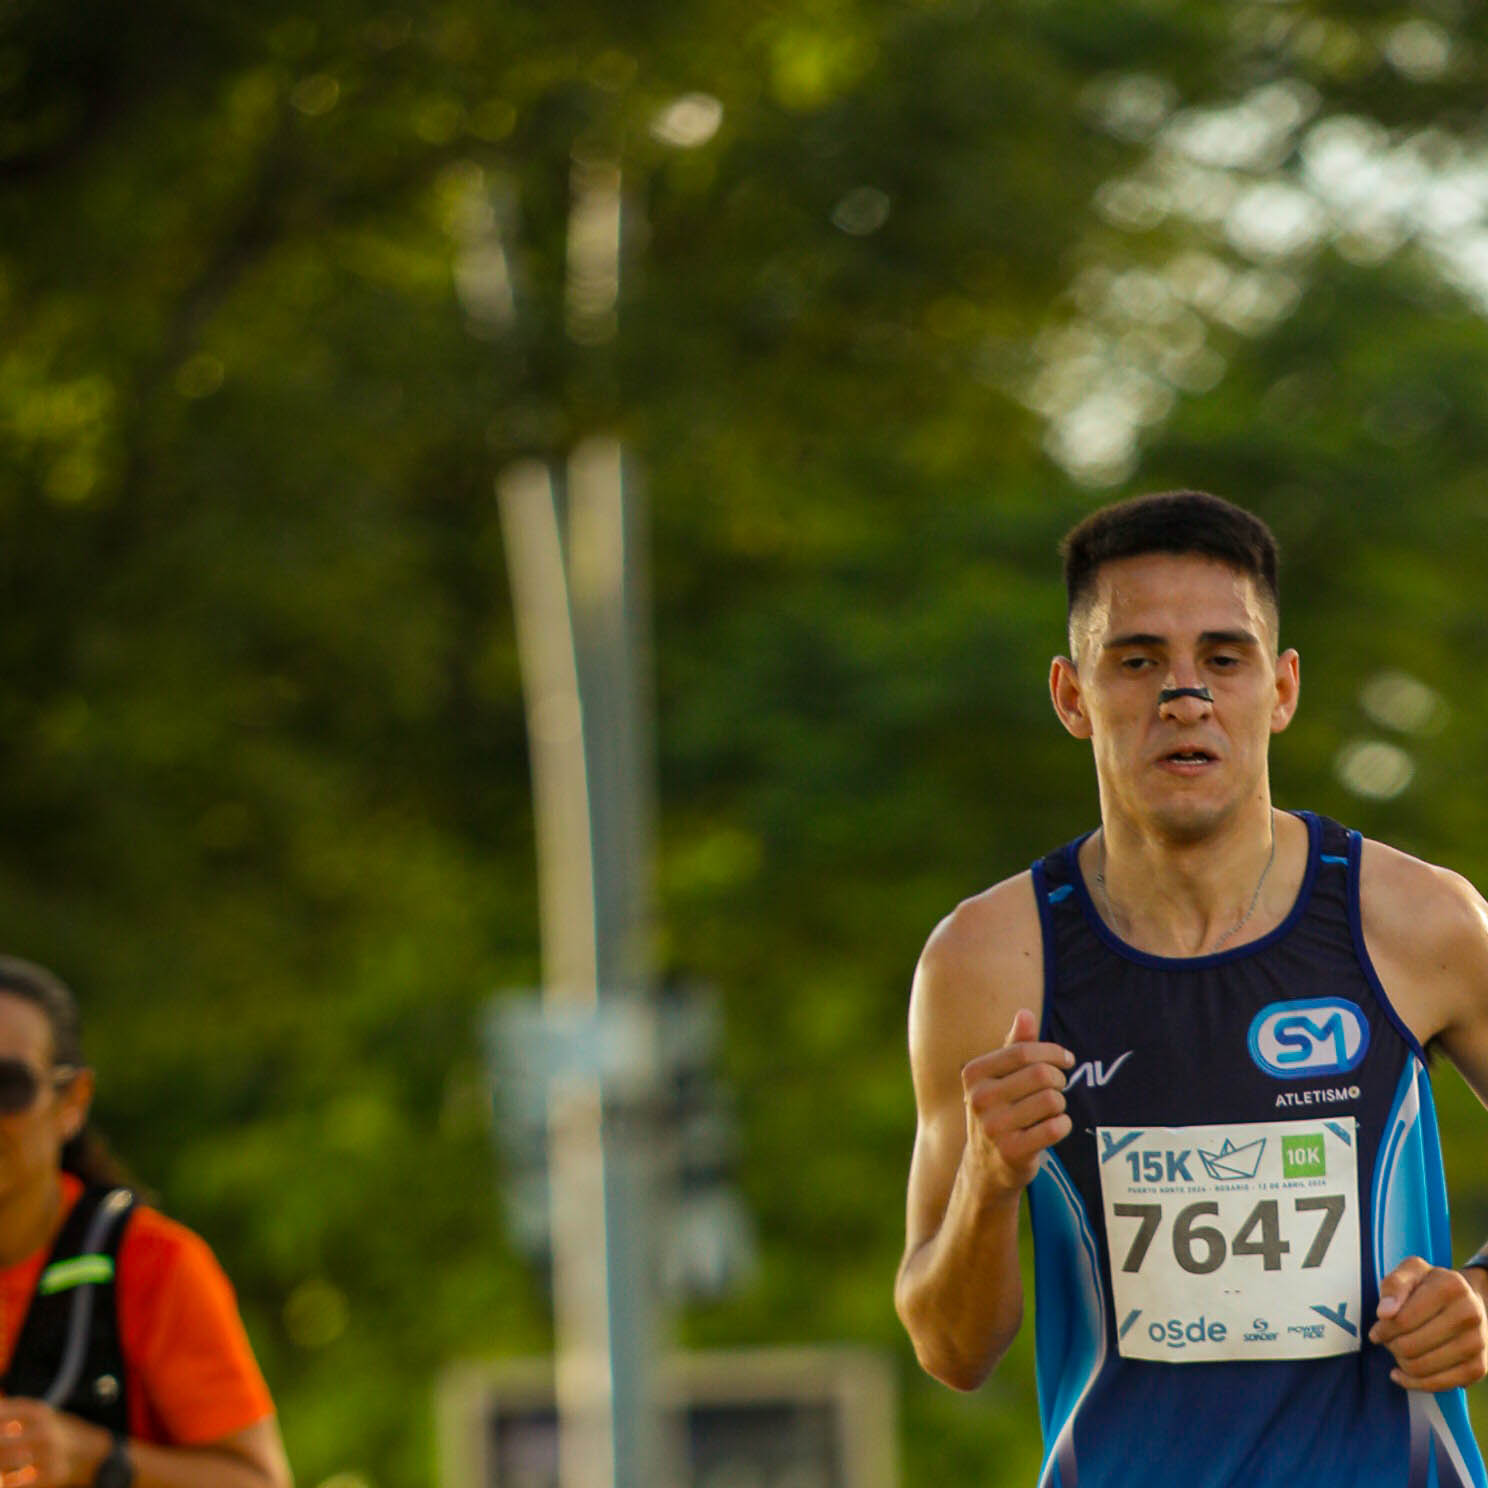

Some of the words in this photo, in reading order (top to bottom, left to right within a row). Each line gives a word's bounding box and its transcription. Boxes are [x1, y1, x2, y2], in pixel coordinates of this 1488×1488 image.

[1273, 1012, 1349, 1070] SM
[1275, 1085, 1361, 1108] ATLETISMO
[1126, 1149, 1194, 1183] 15K
[1286, 1147, 1320, 1167] 10K
[1113, 1194, 1347, 1275] 7647
[1148, 1315, 1228, 1344] osde
